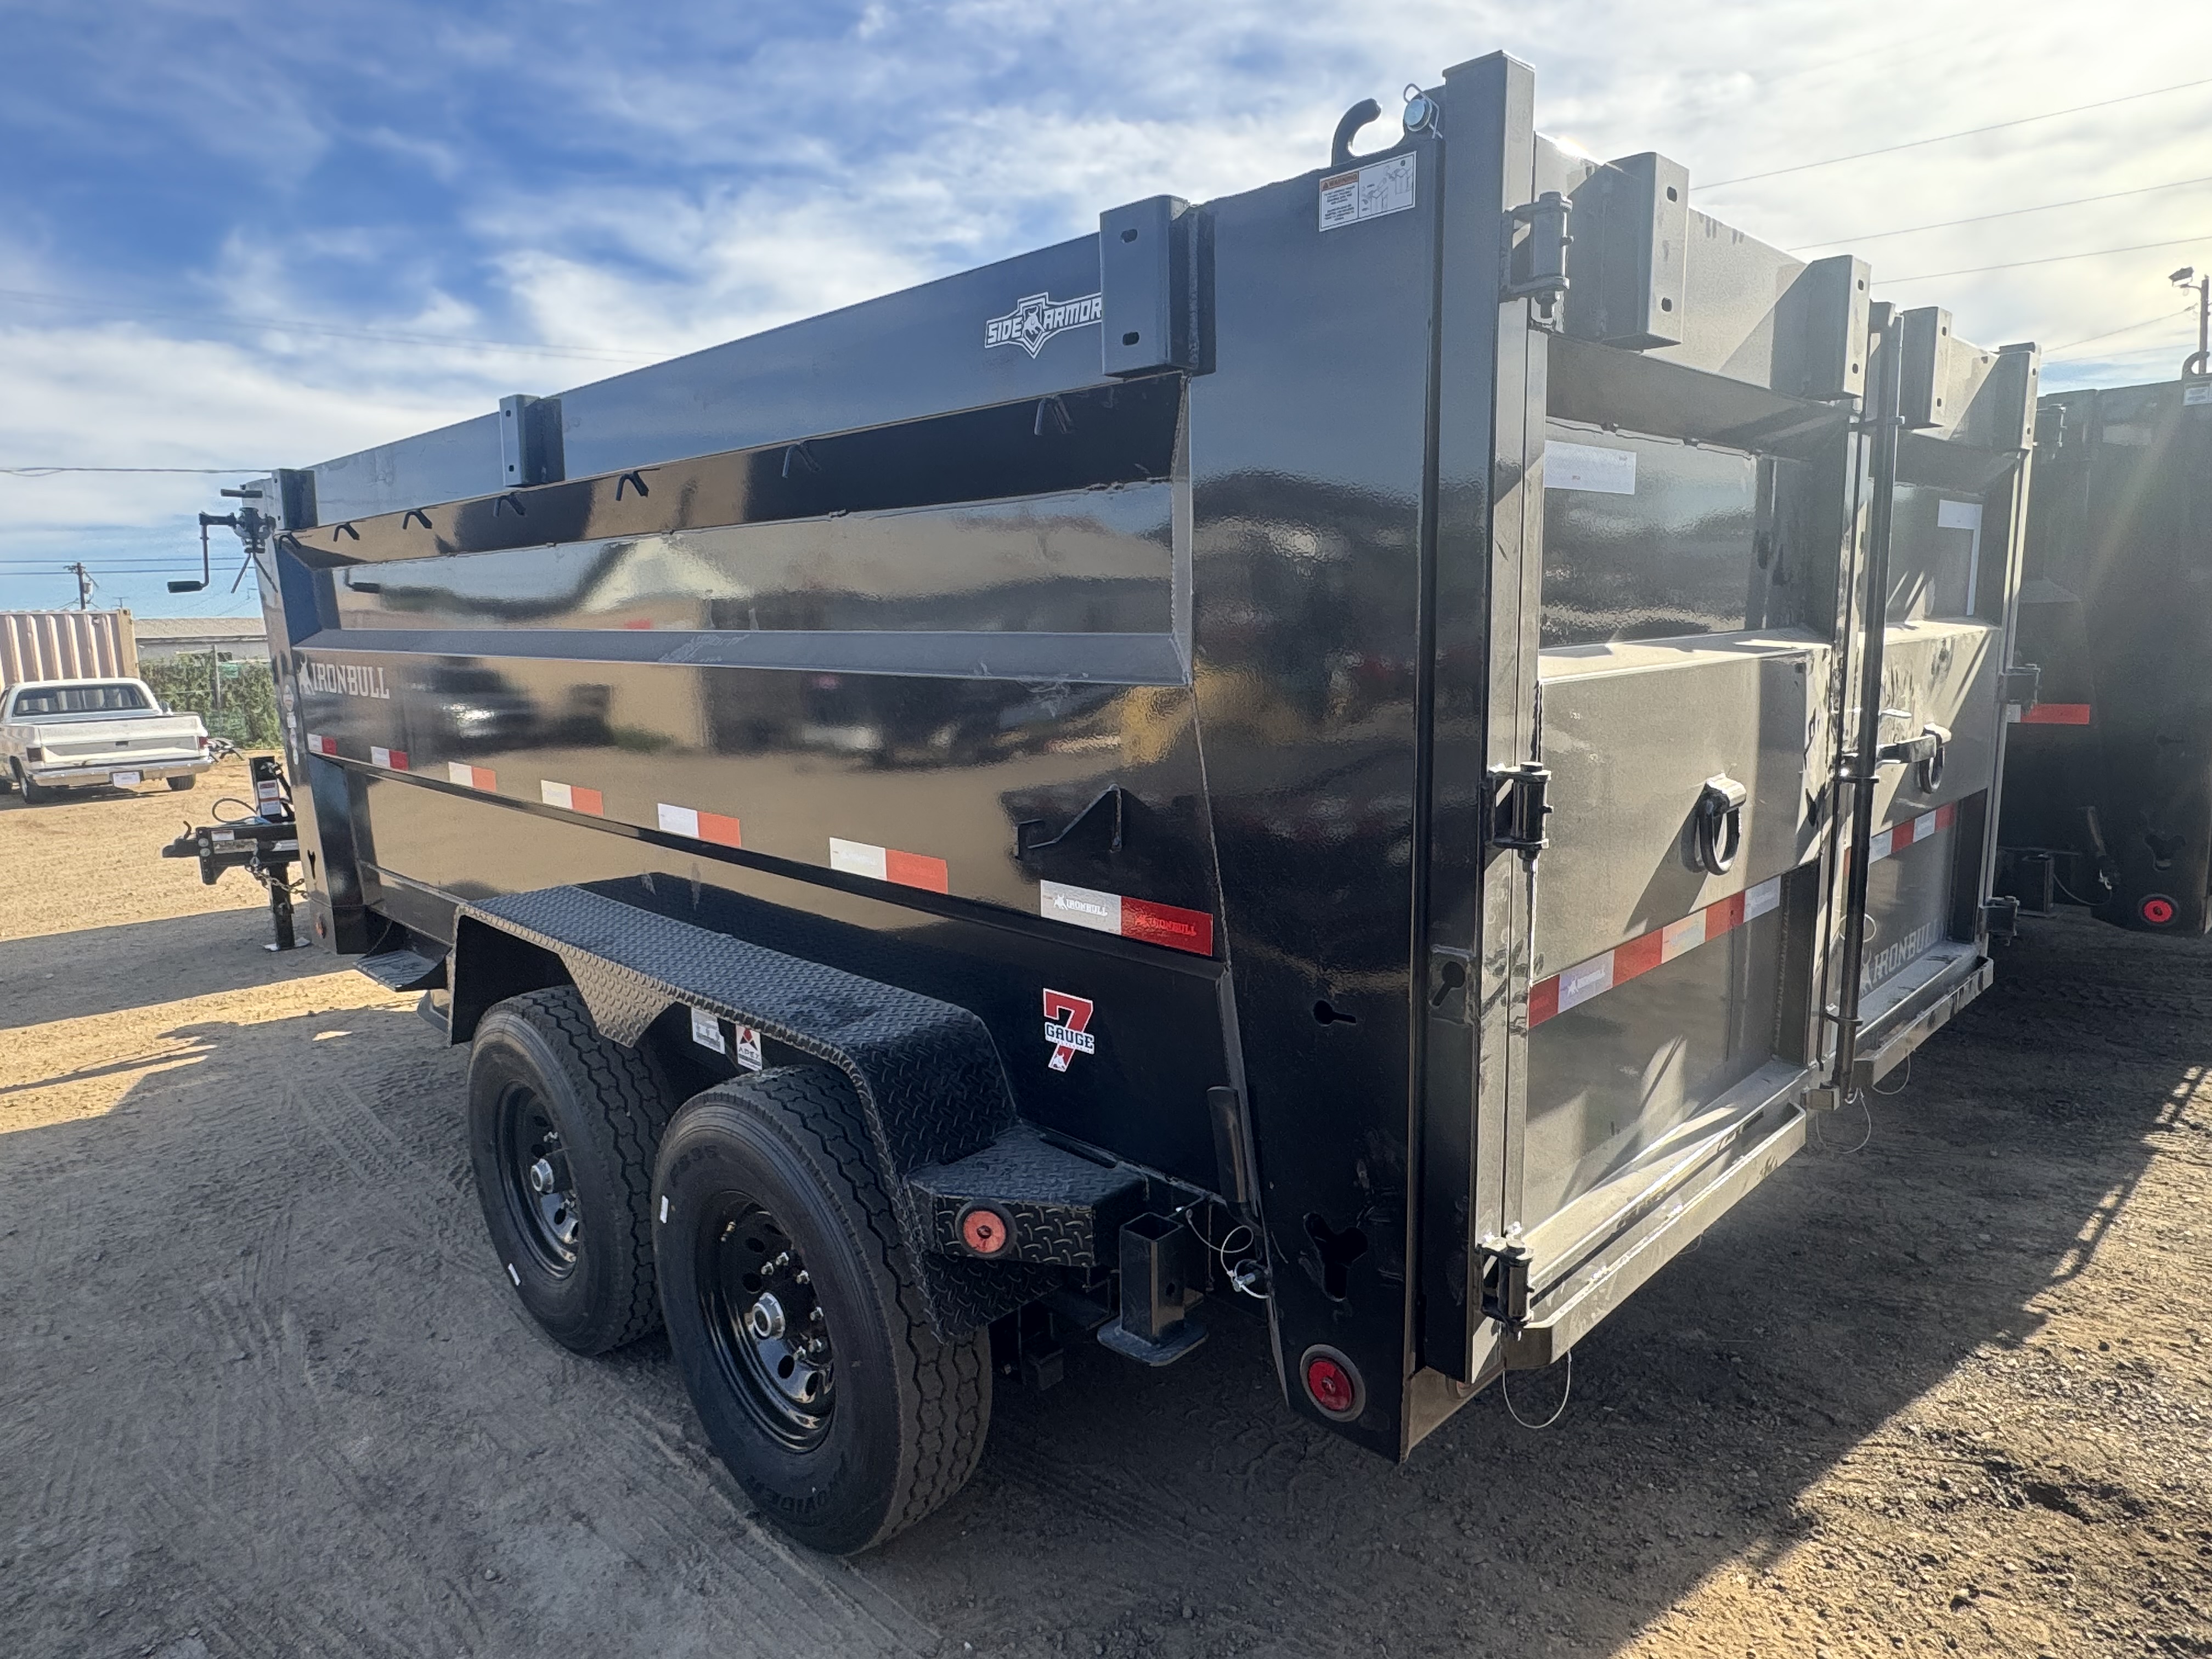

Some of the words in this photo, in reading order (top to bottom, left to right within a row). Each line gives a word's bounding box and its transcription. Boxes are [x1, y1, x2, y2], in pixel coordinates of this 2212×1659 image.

[988, 318, 1023, 344] SIDE
[1043, 298, 1102, 331] ARMOR
[311, 663, 390, 699] IRONBULL
[1047, 1024, 1093, 1049] GAUGE
